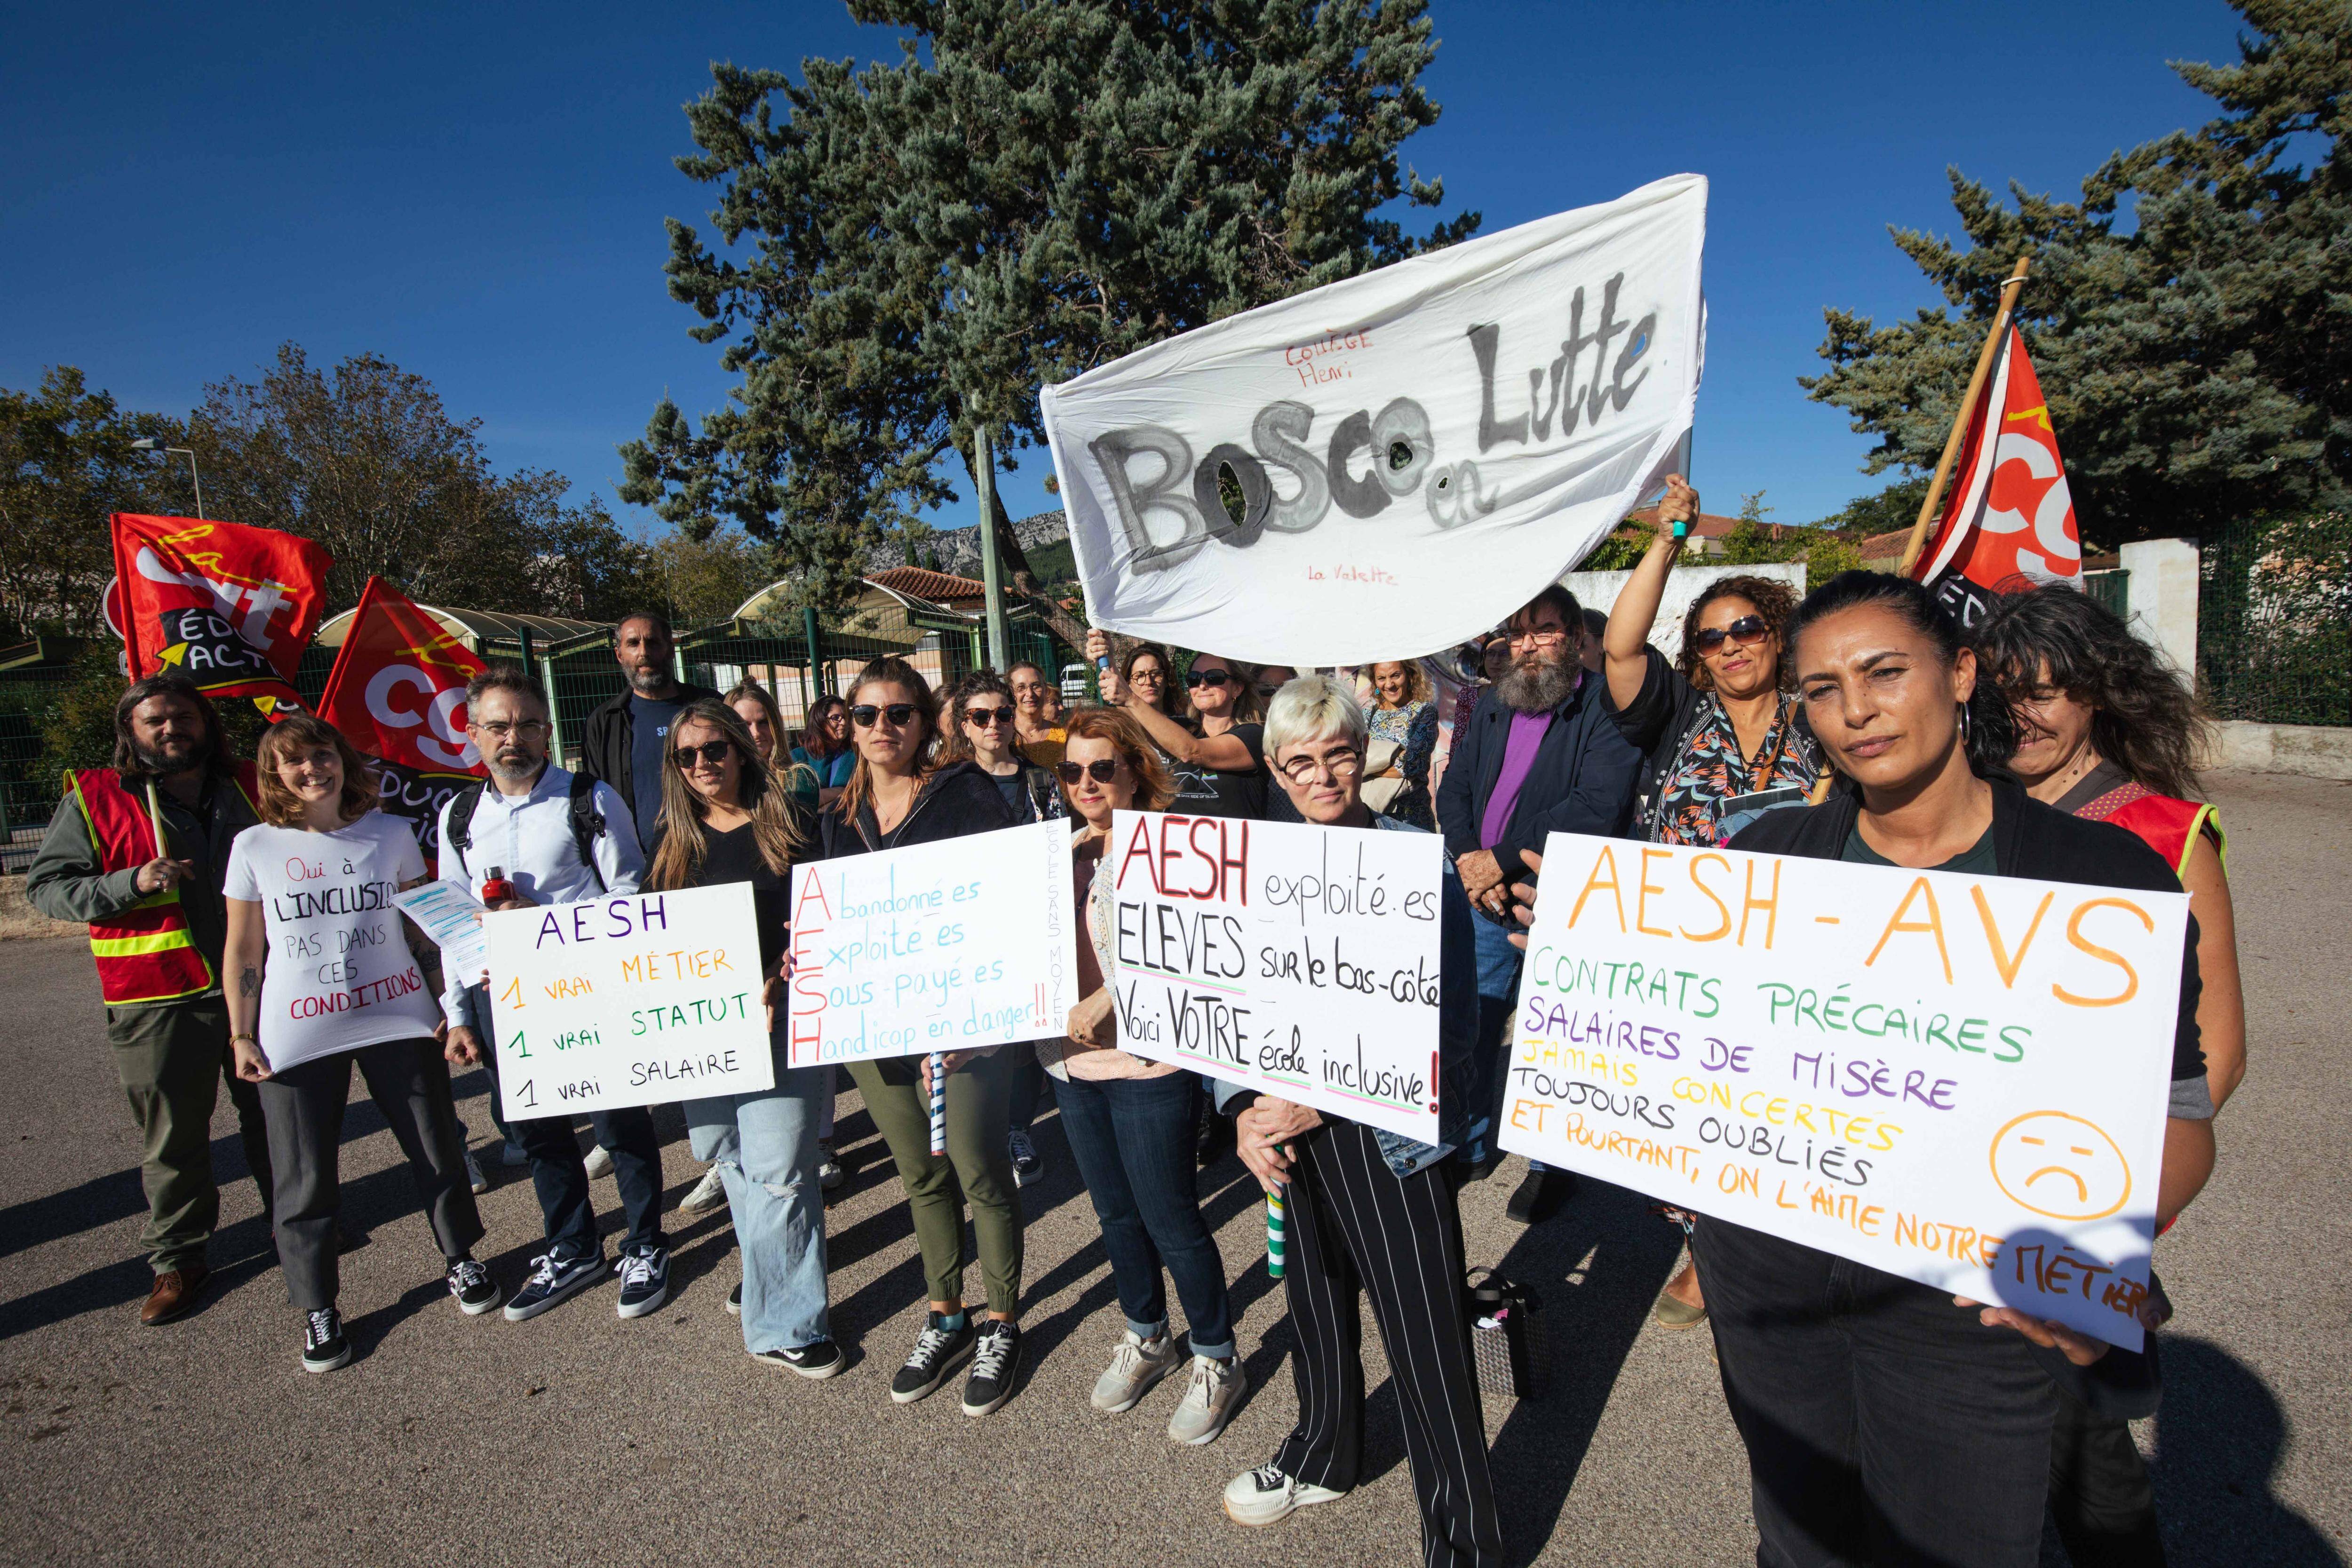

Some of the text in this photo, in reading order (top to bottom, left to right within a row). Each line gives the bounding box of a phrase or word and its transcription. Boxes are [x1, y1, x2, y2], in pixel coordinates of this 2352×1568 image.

[1297, 361, 1352, 388] Henri
[1088, 271, 1657, 575] BOSCO en Lutte
[1308, 564, 1399, 586] La Valette
[364, 664, 482, 769] cg
[286, 857, 356, 882] Oui à
[1116, 815, 1249, 907] AESH
[535, 894, 667, 949] AESH
[1048, 884, 1061, 937] SANS
[1566, 844, 1782, 949] AESH
[1864, 876, 2154, 1008] AVS
[283, 923, 386, 959] PAS DANS
[1118, 901, 1246, 979] ELEVES
[1304, 935, 1327, 987] le
[1335, 935, 1440, 1008] bas-côté
[290, 966, 422, 1020] CONDITIONS
[318, 958, 358, 985] CES
[501, 976, 526, 1010] 1
[1533, 946, 1723, 1019] CONTRATS
[509, 1030, 533, 1059] 1
[631, 993, 749, 1036] STATUT
[792, 1009, 916, 1064] Handicap
[928, 1019, 954, 1038] en
[1116, 979, 1160, 1043] Voici
[1167, 986, 1251, 1066] VOTRE
[1259, 1024, 1310, 1075] école
[1700, 1037, 1755, 1073] DE
[516, 1079, 539, 1108] 1
[1512, 1067, 1676, 1130] TOUJOURS
[1510, 1098, 1555, 1133] ET
[1565, 1112, 1701, 1185] POURTANT,
[1717, 1162, 1760, 1199] ON
[1894, 1211, 2006, 1269] NOTRE
